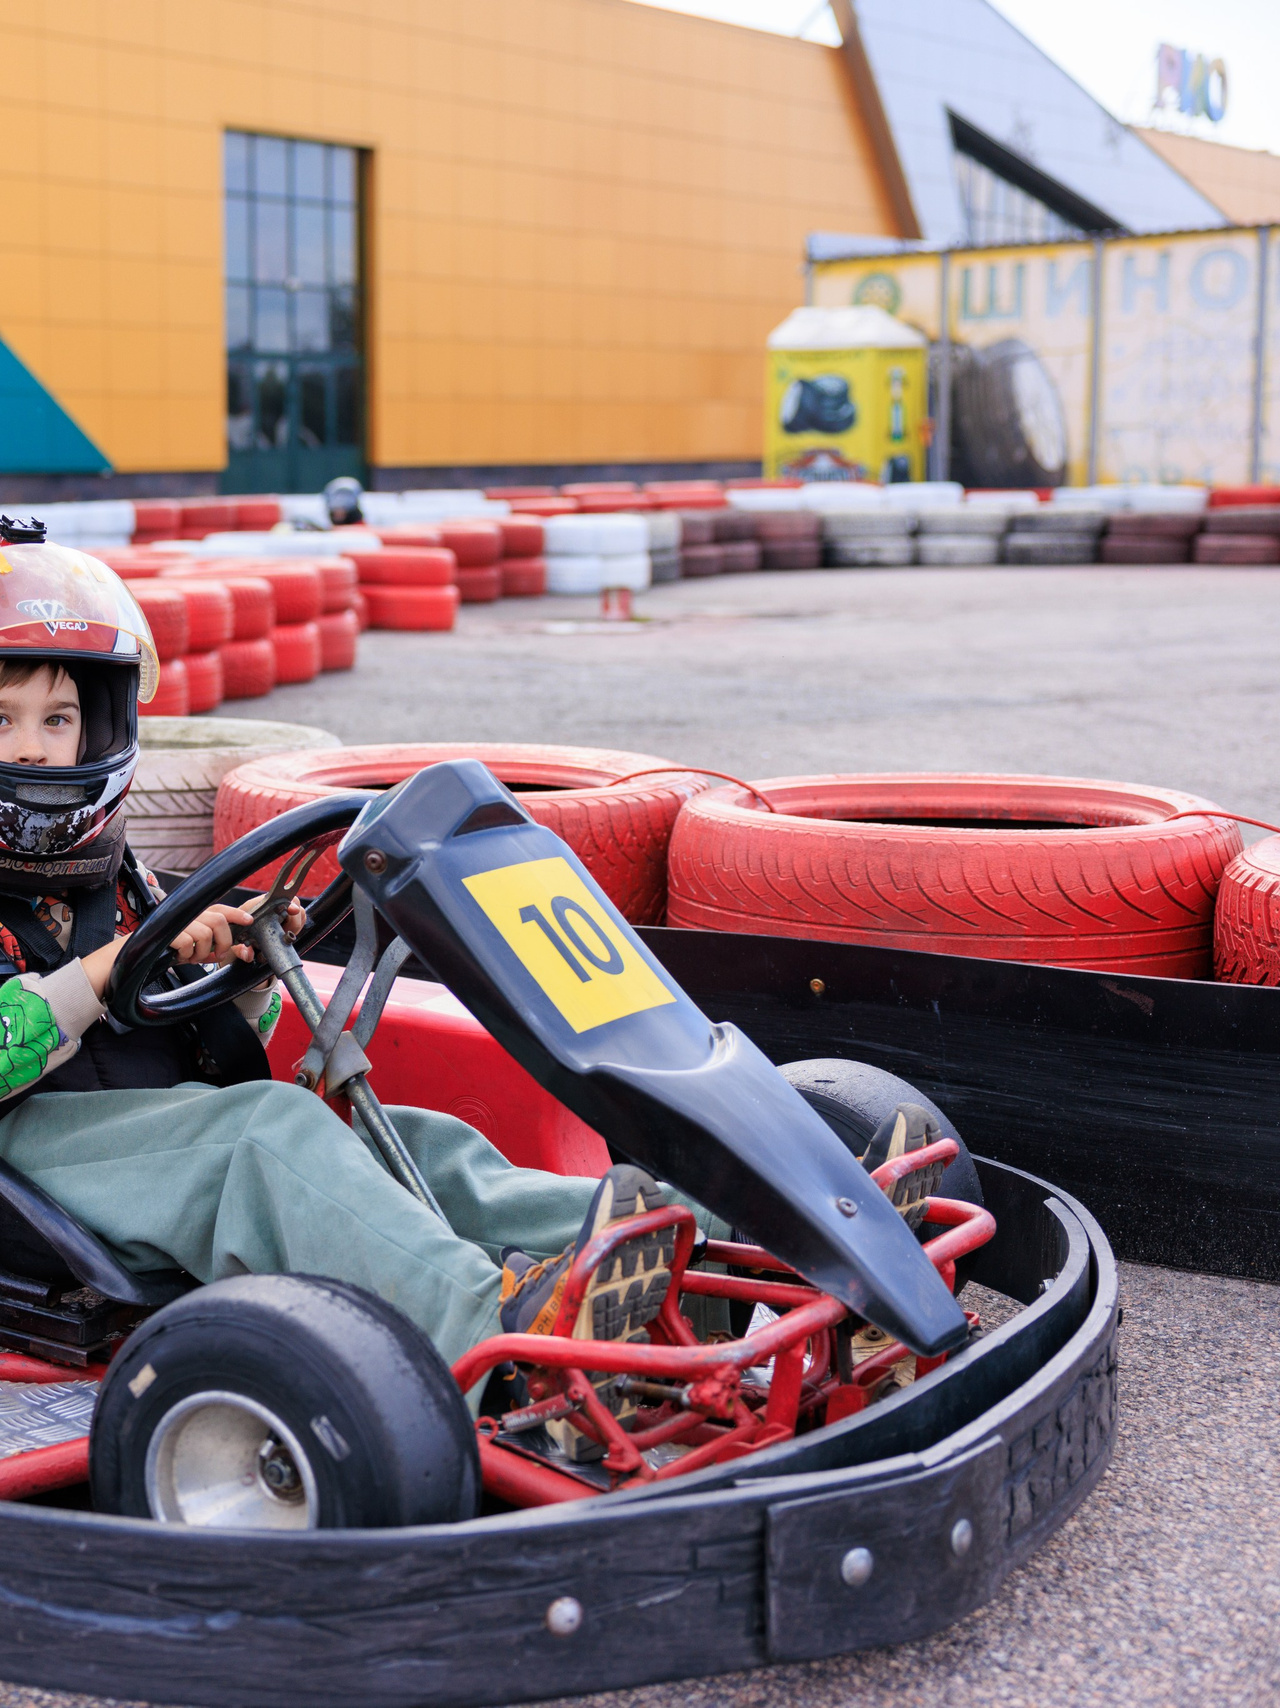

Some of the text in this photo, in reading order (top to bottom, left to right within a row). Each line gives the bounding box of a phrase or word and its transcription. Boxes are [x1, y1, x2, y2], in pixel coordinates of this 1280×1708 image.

[960, 246, 1280, 321] ШИНО
[50, 621, 82, 631] VEGA
[518, 895, 625, 984] 10
